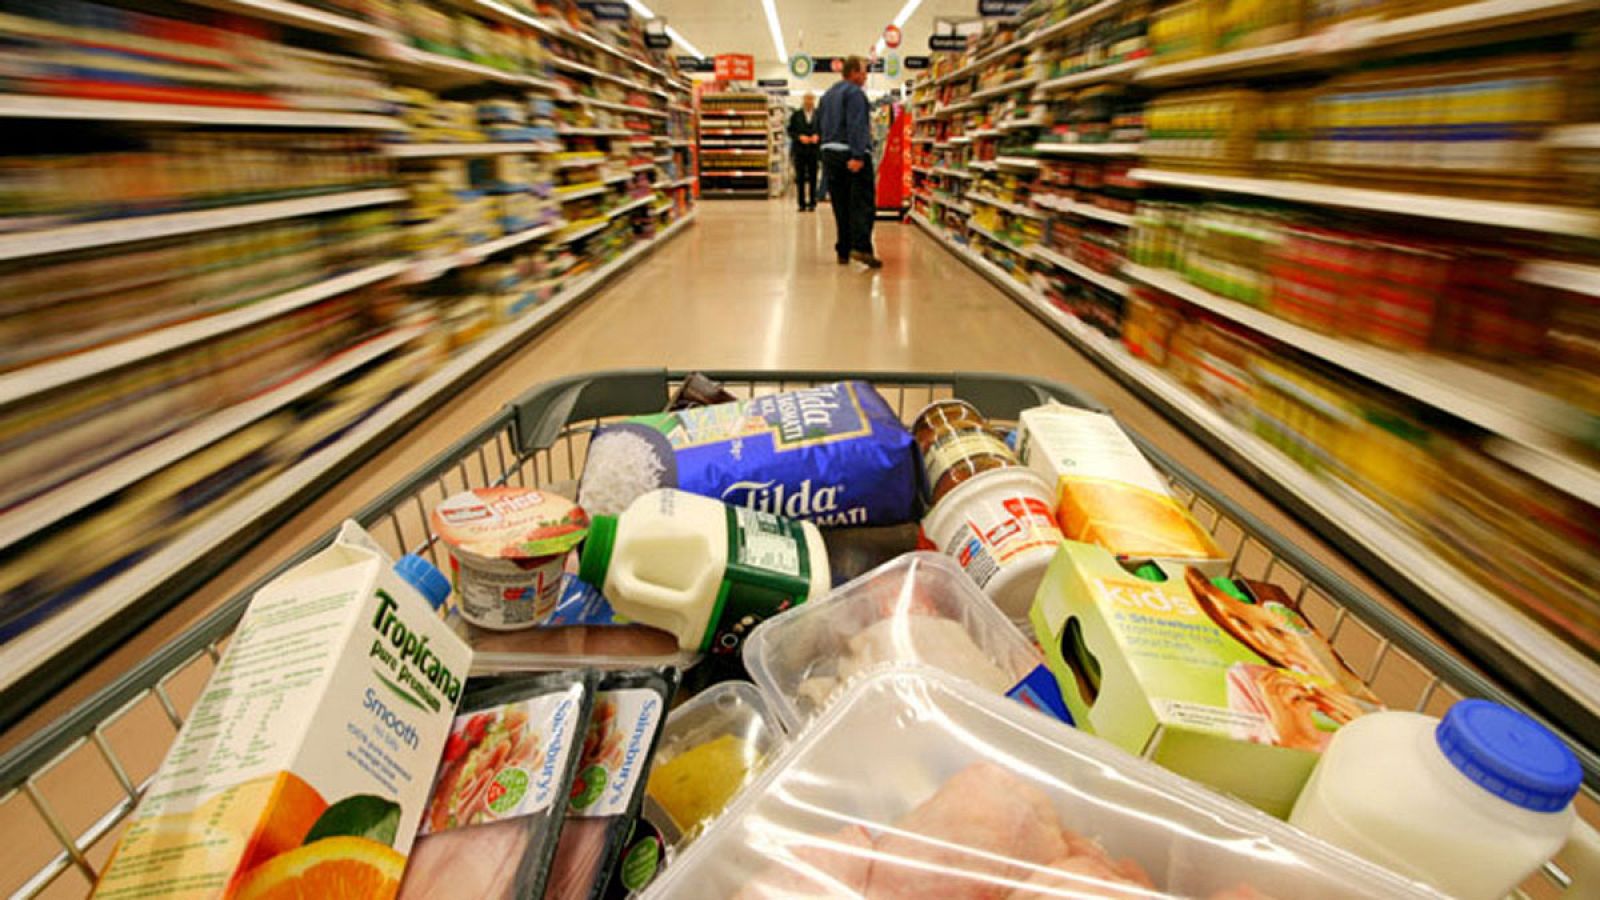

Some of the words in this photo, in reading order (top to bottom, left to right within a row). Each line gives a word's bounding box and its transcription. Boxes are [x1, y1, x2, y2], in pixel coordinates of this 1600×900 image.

[721, 479, 838, 517] Tilda
[815, 506, 868, 526] MATI
[1093, 577, 1199, 616] kids
[369, 638, 399, 671] pure
[371, 586, 461, 705] Tropicana
[362, 687, 420, 751] Smooth
[534, 698, 575, 804] Sainsbury's
[609, 698, 658, 805] Sainsbury's
